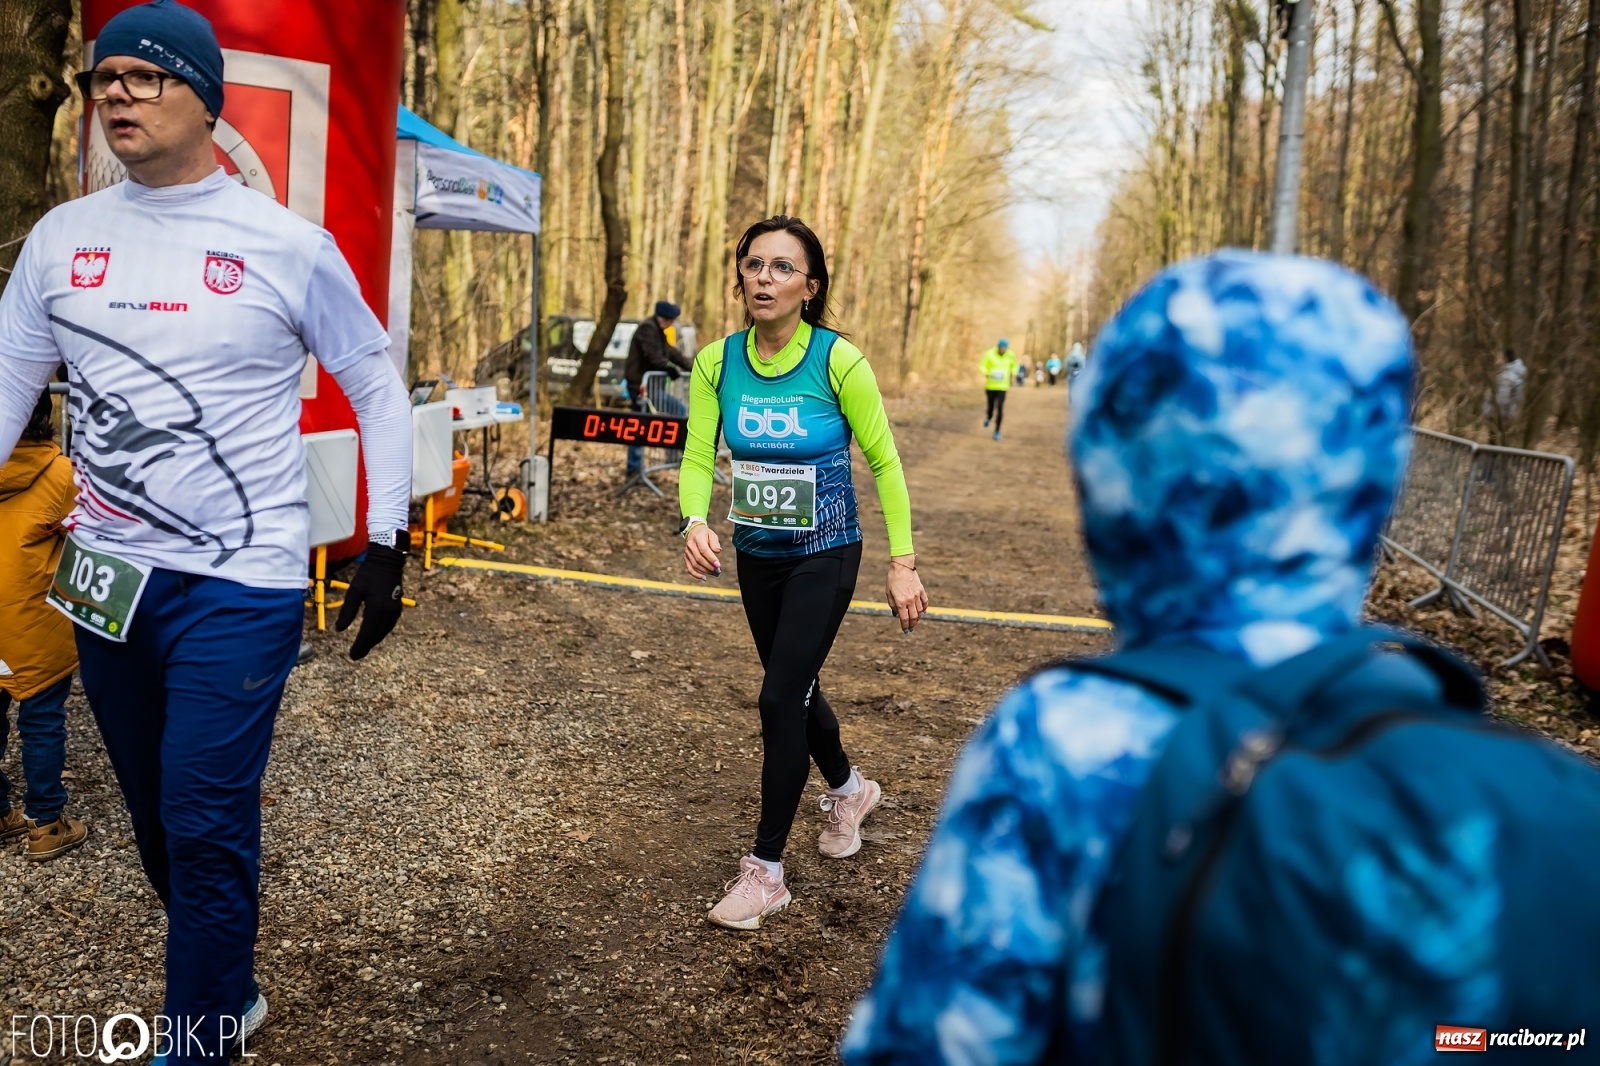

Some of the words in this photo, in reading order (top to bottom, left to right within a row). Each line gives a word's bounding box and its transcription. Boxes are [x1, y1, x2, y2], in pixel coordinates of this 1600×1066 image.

[583, 414, 679, 444] 0:42:03
[737, 406, 808, 438] bbl
[749, 441, 796, 449] RACIBÓRZ
[746, 463, 760, 472] BIEG
[761, 466, 805, 475] Twardziela
[746, 483, 797, 511] 092
[69, 549, 116, 603] 103
